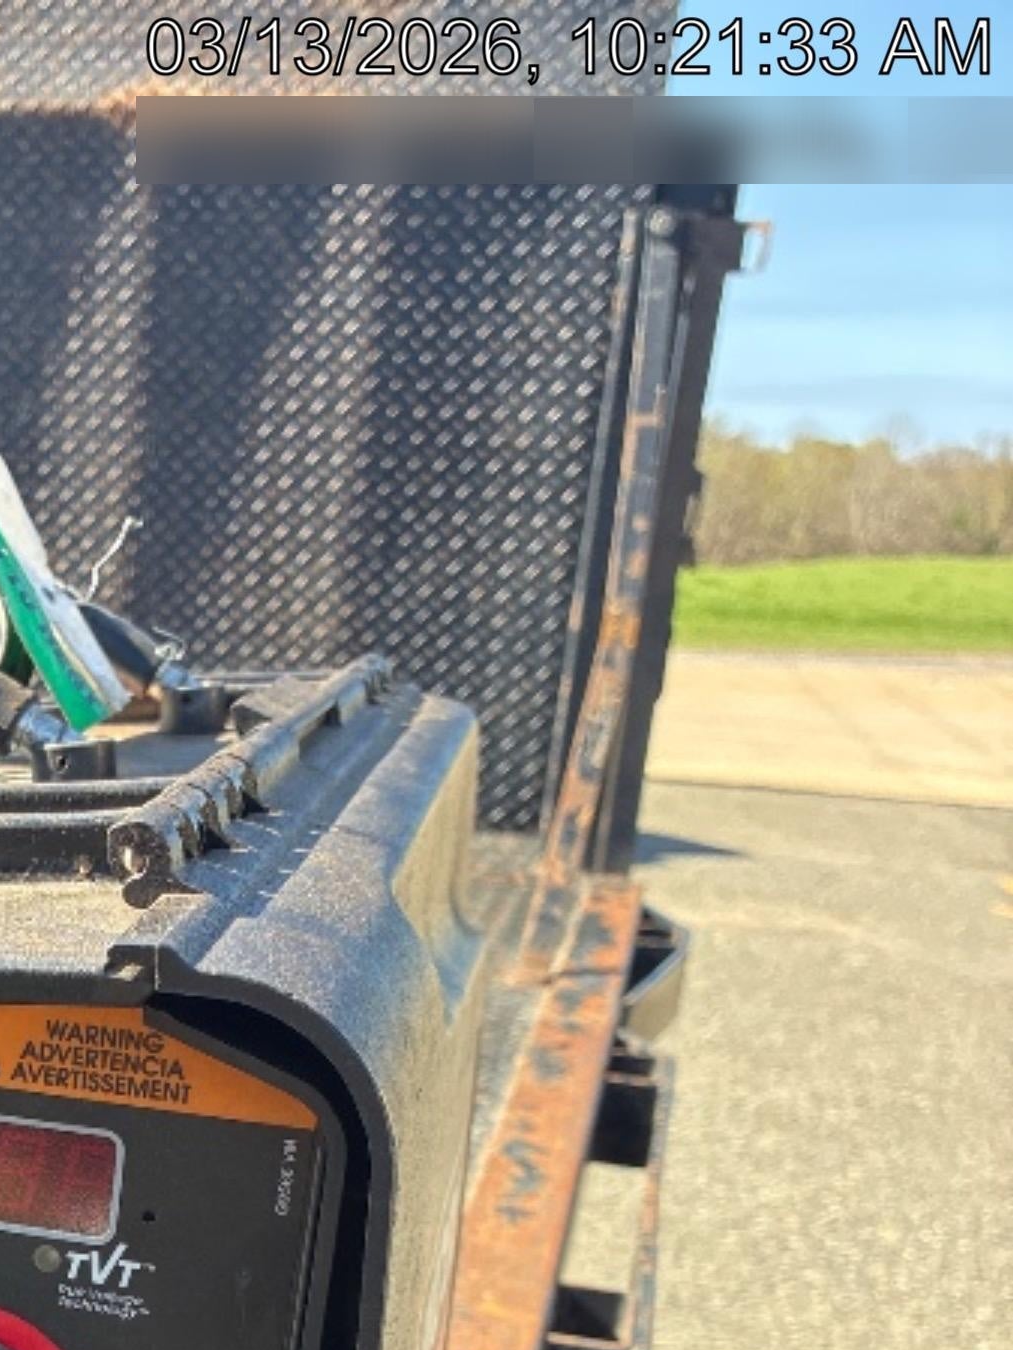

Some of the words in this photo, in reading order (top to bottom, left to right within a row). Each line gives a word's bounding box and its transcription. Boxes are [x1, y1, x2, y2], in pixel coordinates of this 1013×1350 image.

[46, 1019, 165, 1054] WARNING
[19, 1040, 185, 1081] ADVERTENCIA
[10, 1062, 193, 1105] AVERTISSEMENT
